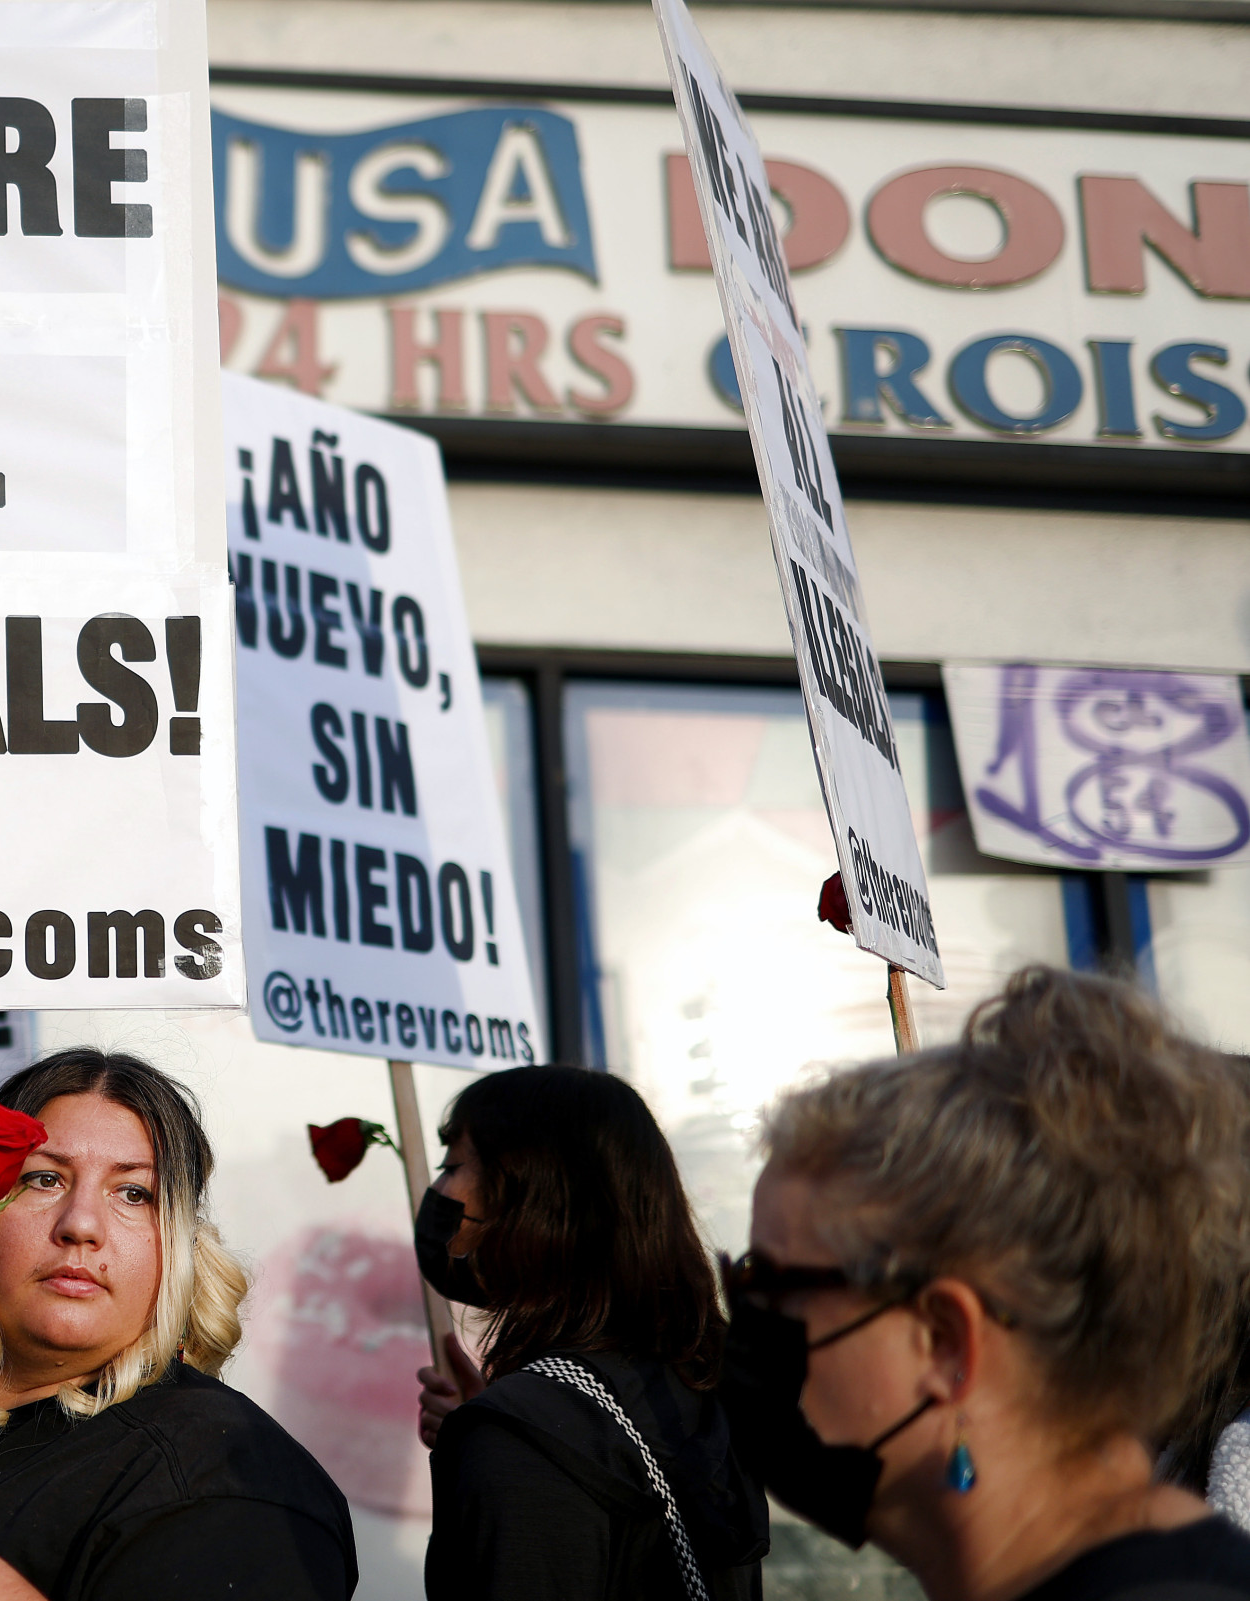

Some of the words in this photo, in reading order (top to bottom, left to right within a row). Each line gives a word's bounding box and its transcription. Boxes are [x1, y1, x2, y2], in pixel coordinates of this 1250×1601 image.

[225, 120, 576, 278] USA
[678, 55, 751, 252] WE
[387, 302, 636, 420] HRS
[707, 322, 1250, 443] ROIS
[238, 429, 391, 555] ¡AÑO
[771, 355, 834, 537] ALL
[311, 703, 418, 817] SIN
[264, 826, 500, 966] MIEDO!
[263, 970, 535, 1064] @therevcoms
